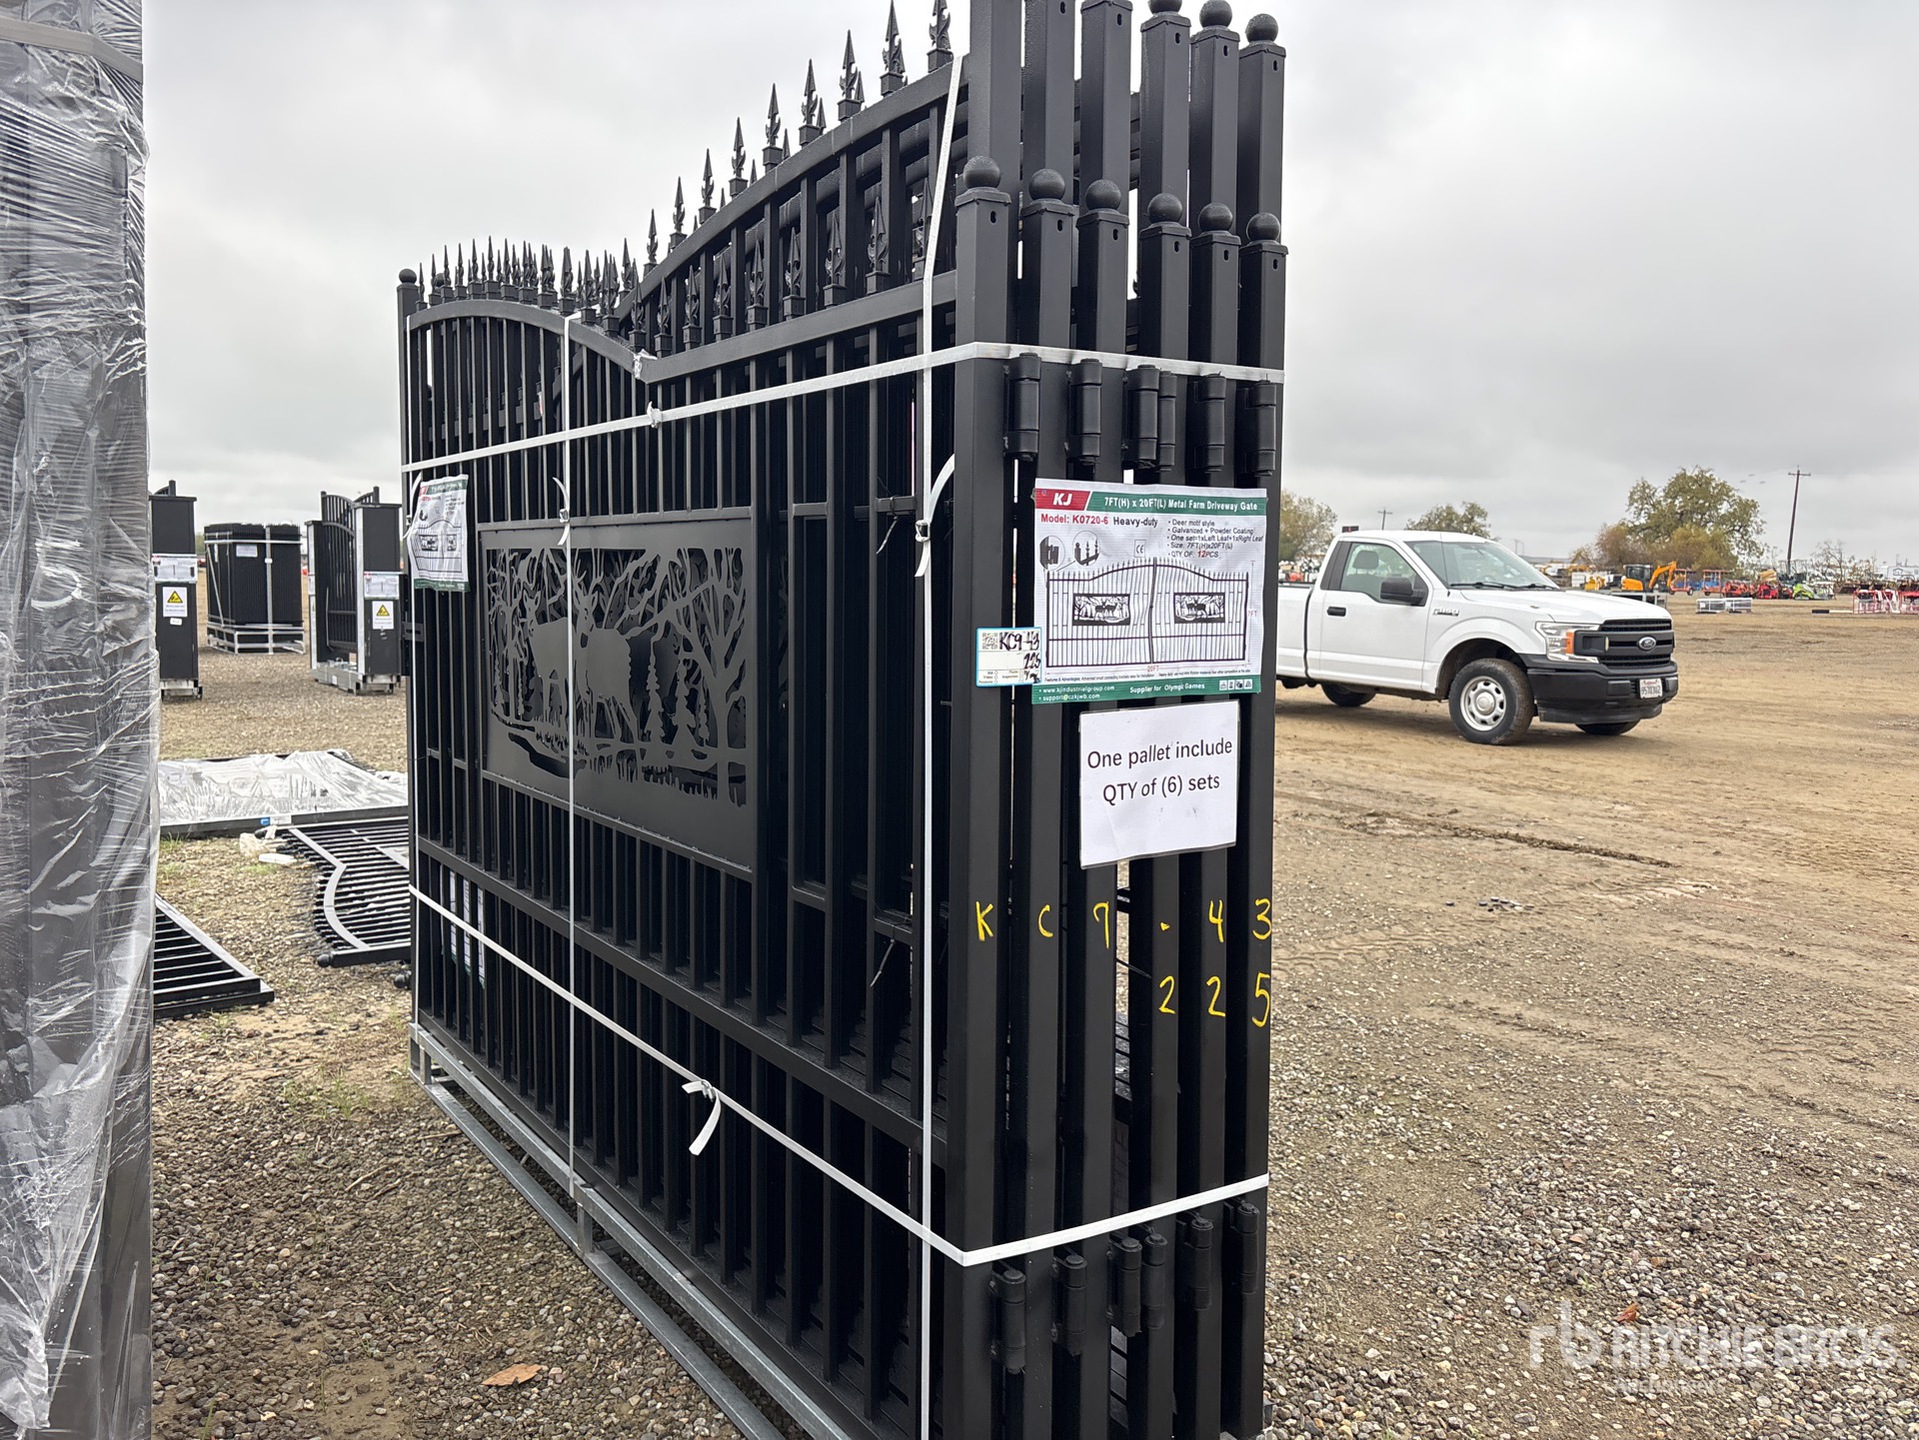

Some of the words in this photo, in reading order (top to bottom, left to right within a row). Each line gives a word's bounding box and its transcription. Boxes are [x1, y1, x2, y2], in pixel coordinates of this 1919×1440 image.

[1052, 492, 1073, 506] KJ
[1104, 496, 1130, 509] 7FT(H)
[1132, 499, 1137, 508] x
[1138, 497, 1166, 510] 20FT(L)
[1167, 499, 1187, 509] Metal
[1188, 499, 1205, 509] Farm
[1206, 500, 1238, 513] Driveway
[1239, 501, 1258, 511] Gate
[1040, 513, 1070, 524] Model:
[1072, 515, 1109, 525] K0720-6
[1113, 516, 1158, 528] Heavy-duty
[1202, 520, 1215, 528] style
[1171, 534, 1184, 542] One
[1232, 528, 1254, 536] Coating
[1130, 686, 1153, 694] Supplier
[1153, 684, 1162, 692] for
[1164, 683, 1184, 692] Olympic
[1184, 682, 1205, 690] Games
[1087, 750, 1123, 769] One
[1128, 744, 1171, 769] pallet
[1175, 737, 1233, 759] include
[1103, 781, 1138, 806] QTY
[1141, 777, 1158, 797] of
[1161, 775, 1183, 798] (6)
[1188, 774, 1220, 791] sets
